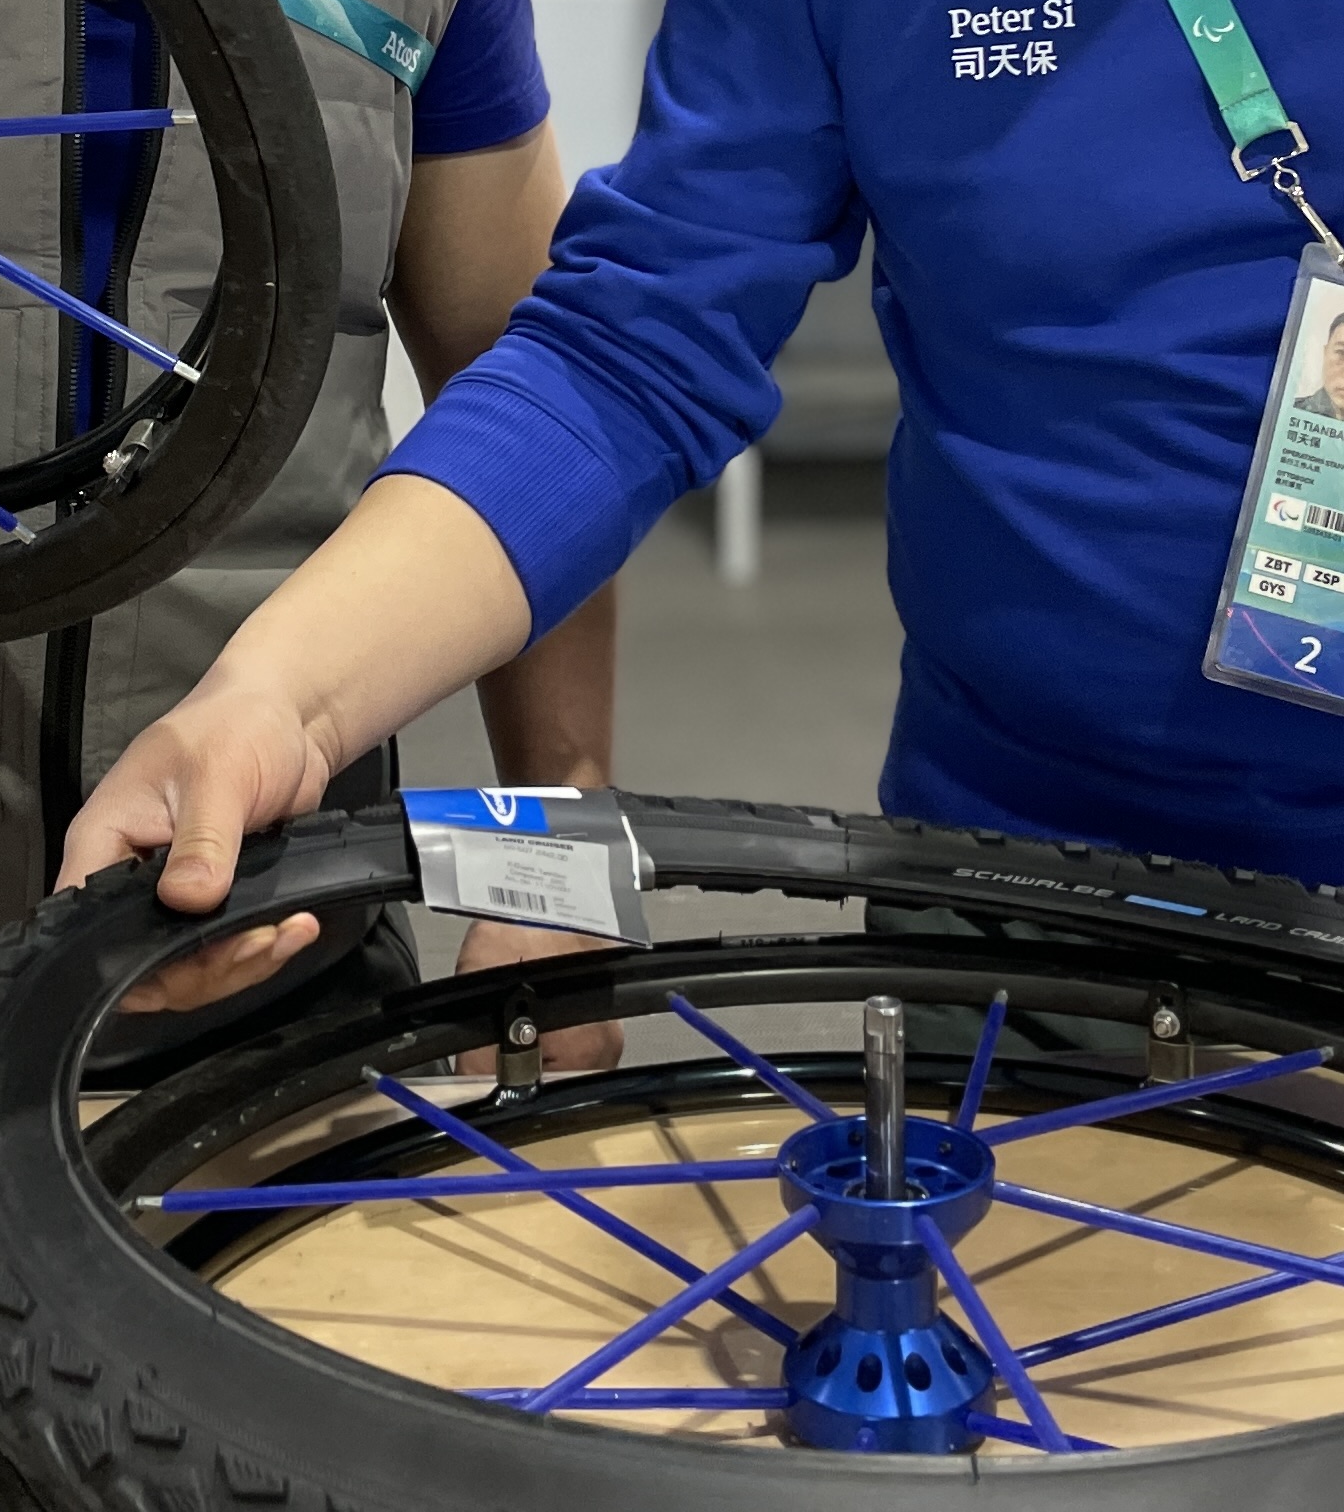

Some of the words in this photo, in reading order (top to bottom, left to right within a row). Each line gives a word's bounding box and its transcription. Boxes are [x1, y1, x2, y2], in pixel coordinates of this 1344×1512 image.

[947, 6, 1036, 38] Peter
[951, 40, 1058, 81] 司天保
[1289, 417, 1301, 428] SI
[1264, 556, 1292, 573] ZBT
[1313, 570, 1340, 586] ZSP
[1259, 580, 1286, 597] GYS
[1294, 636, 1322, 674] 2
[953, 867, 1115, 899] SCHWALBE
[1214, 912, 1283, 931] LAND
